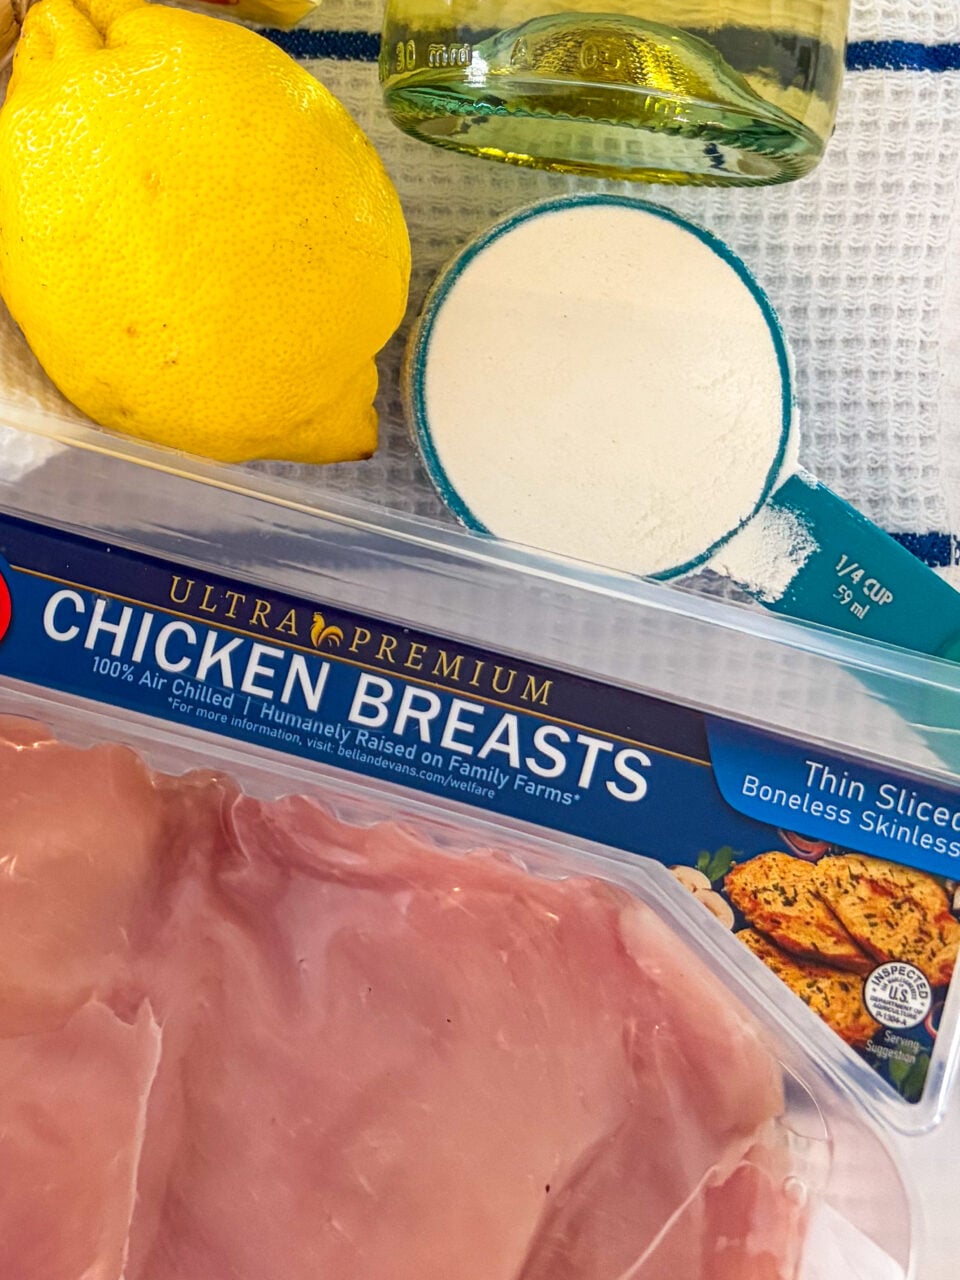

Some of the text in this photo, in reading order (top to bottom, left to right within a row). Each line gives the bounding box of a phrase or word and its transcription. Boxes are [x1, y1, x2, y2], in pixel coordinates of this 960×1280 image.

[834, 554, 894, 605] 1/4 CUP
[849, 601, 871, 619] ml
[168, 575, 555, 708] ULTRA PREMIUM
[42, 587, 653, 804] CHICKEN BREASTS
[91, 656, 135, 684] 100%
[138, 667, 169, 693] Air
[171, 677, 235, 711] Chilled
[260, 702, 350, 744] Humanely
[355, 728, 416, 762] Raised
[421, 750, 444, 768] on
[448, 752, 510, 791] Family
[197, 708, 228, 726] more
[231, 712, 305, 748] information,
[306, 735, 335, 757] visit:
[337, 742, 496, 801] bellandevans.com/welfare
[805, 760, 865, 802] Thin
[741, 774, 960, 858] Boneless Skinless
[871, 965, 929, 1000] INSPECTED
[888, 984, 910, 1004] U.S.
[865, 1038, 916, 1065] Suggestion
[883, 1029, 920, 1055] Serving
